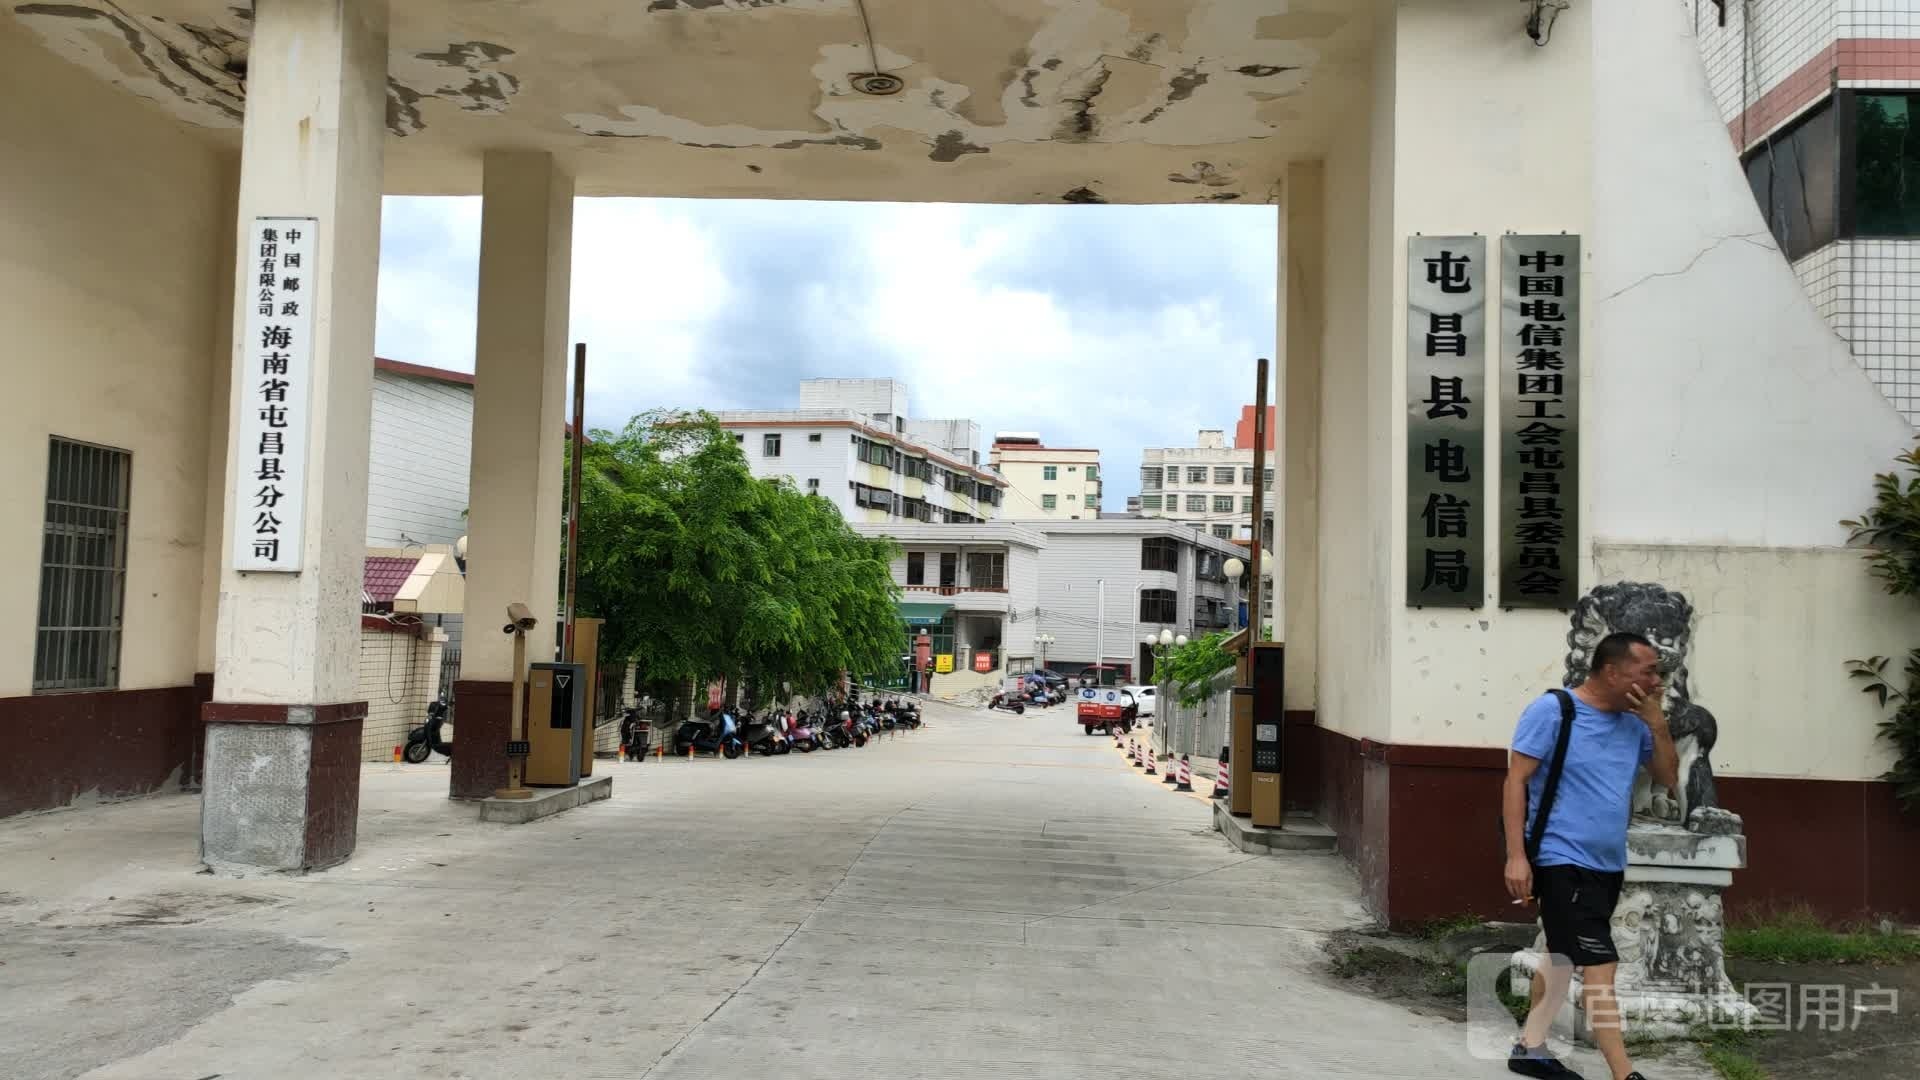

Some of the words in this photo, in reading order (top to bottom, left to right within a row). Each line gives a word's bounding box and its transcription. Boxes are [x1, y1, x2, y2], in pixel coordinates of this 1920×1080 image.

[258, 228, 278, 318] 集团有限公司
[281, 228, 301, 318] 中国邮政
[252, 325, 293, 562] 海南省屯昌县分公司
[1420, 250, 1471, 593] 屯昌县电信局
[1515, 250, 1567, 595] 中国电信集团工会屯昌县委员会
